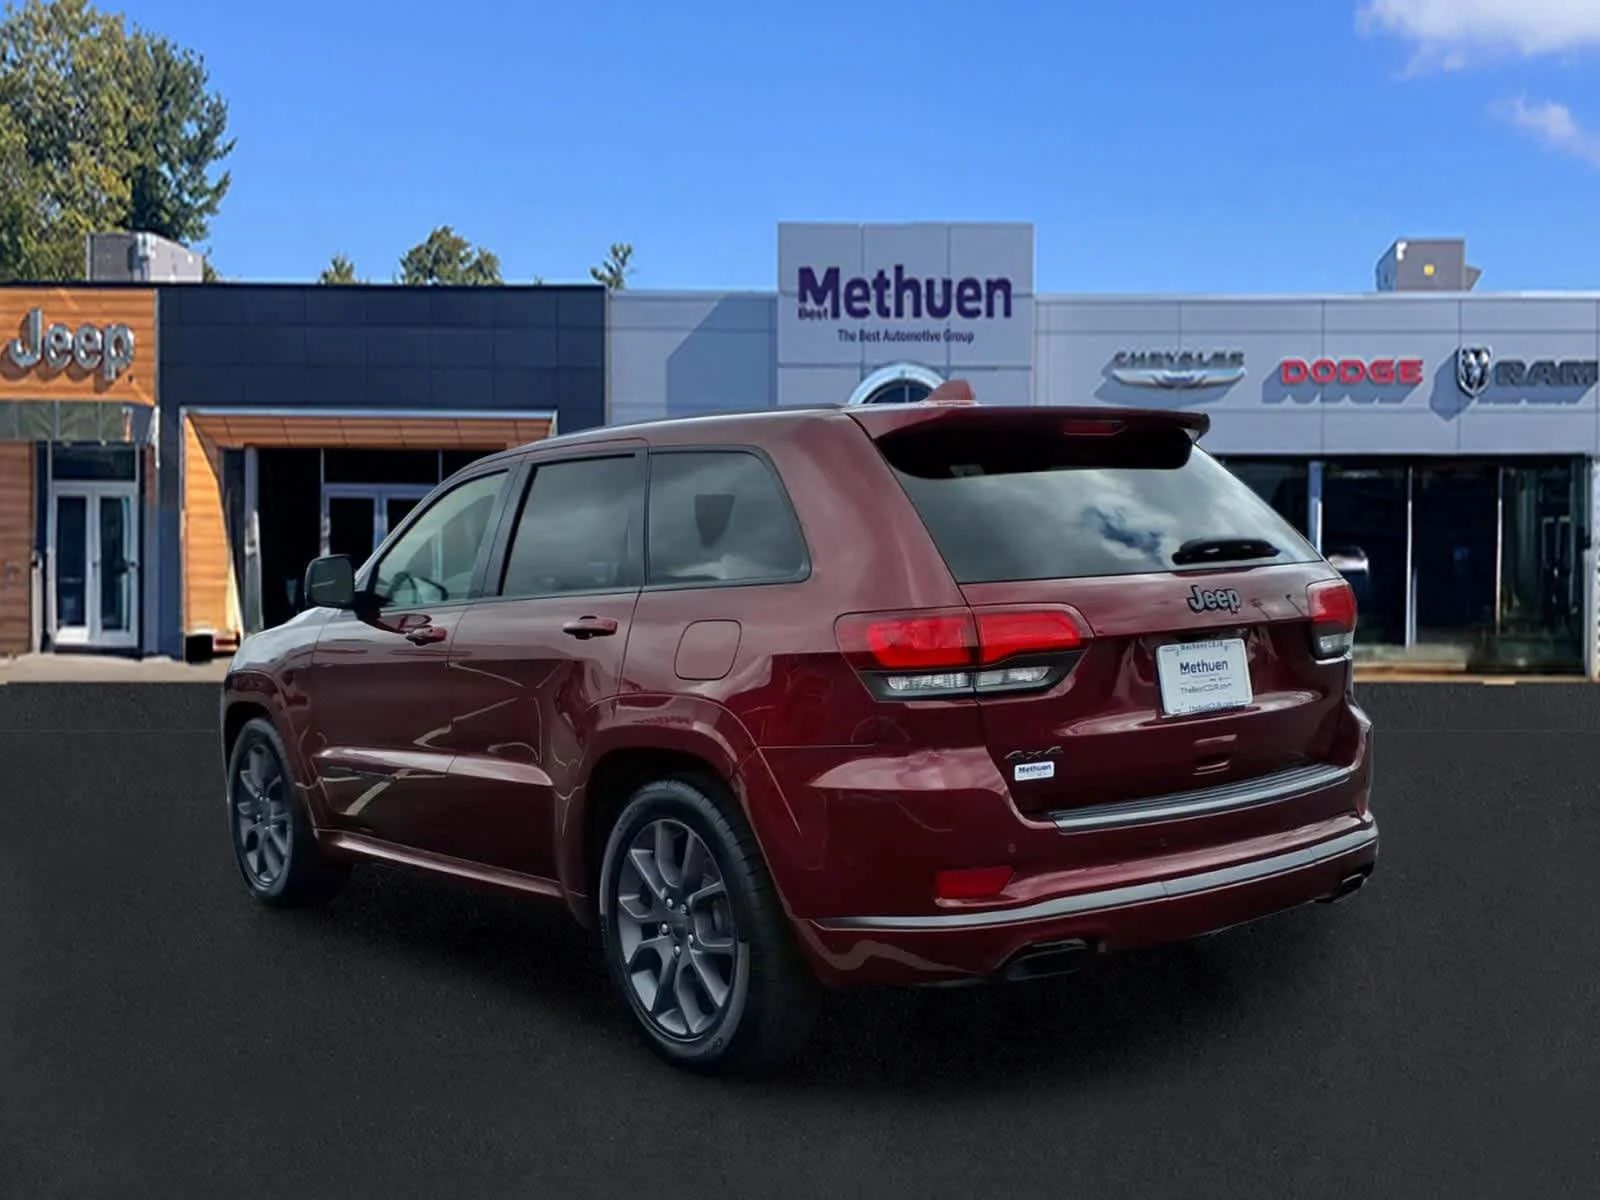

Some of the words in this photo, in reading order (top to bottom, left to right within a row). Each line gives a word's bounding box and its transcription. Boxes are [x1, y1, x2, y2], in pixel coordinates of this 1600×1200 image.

[798, 264, 1012, 319] Methuen
[798, 307, 828, 321] Best
[8, 308, 135, 381] Jeep
[837, 328, 857, 342] The
[859, 328, 880, 342] Best
[883, 328, 941, 342] Automotive
[943, 328, 973, 344] Group
[1114, 351, 1245, 368] CHRYSLER
[1281, 358, 1423, 384] DODGE
[1494, 360, 1598, 387] RAM
[1187, 585, 1241, 615] Jeep
[1179, 659, 1229, 675] Methuen
